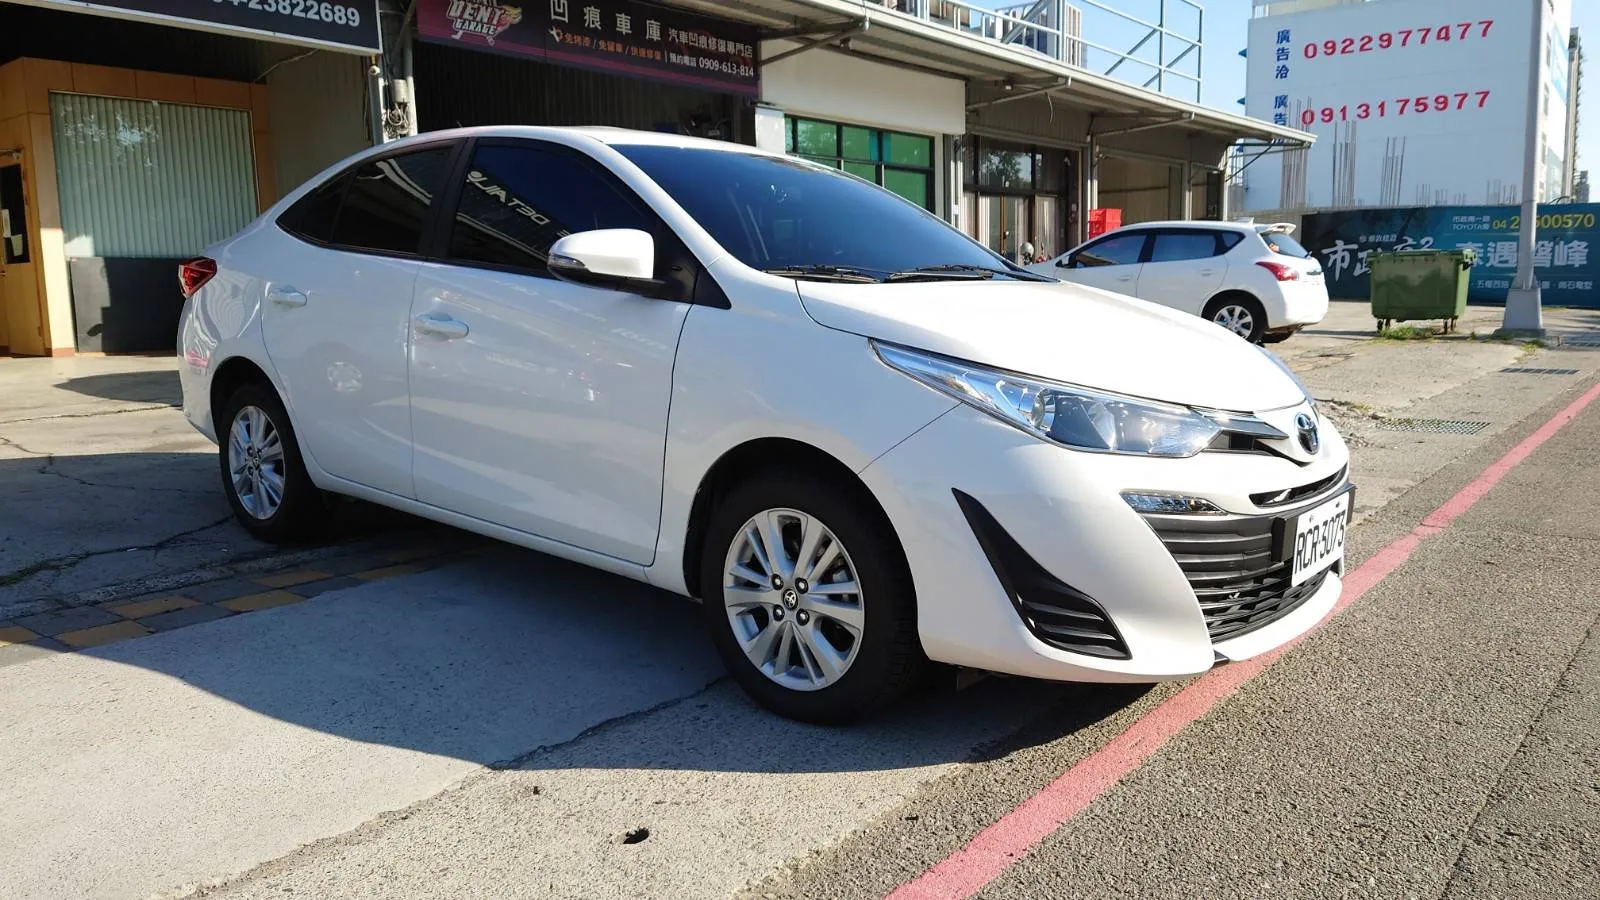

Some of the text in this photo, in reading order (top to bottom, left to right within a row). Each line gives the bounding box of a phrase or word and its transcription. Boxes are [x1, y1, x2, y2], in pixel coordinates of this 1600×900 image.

[213, 0, 361, 27] -23822689
[449, 0, 504, 25] DENT
[455, 18, 497, 35] GARAGE
[550, 0, 662, 41] 凹痕車庫
[1275, 29, 1291, 79] 廣告洽
[1303, 20, 1494, 59] 0922977477
[699, 59, 754, 77] 0909-613-814
[1273, 94, 1288, 144] 廣告
[1301, 90, 1490, 125] 0913175977
[1492, 220, 1506, 229] 04
